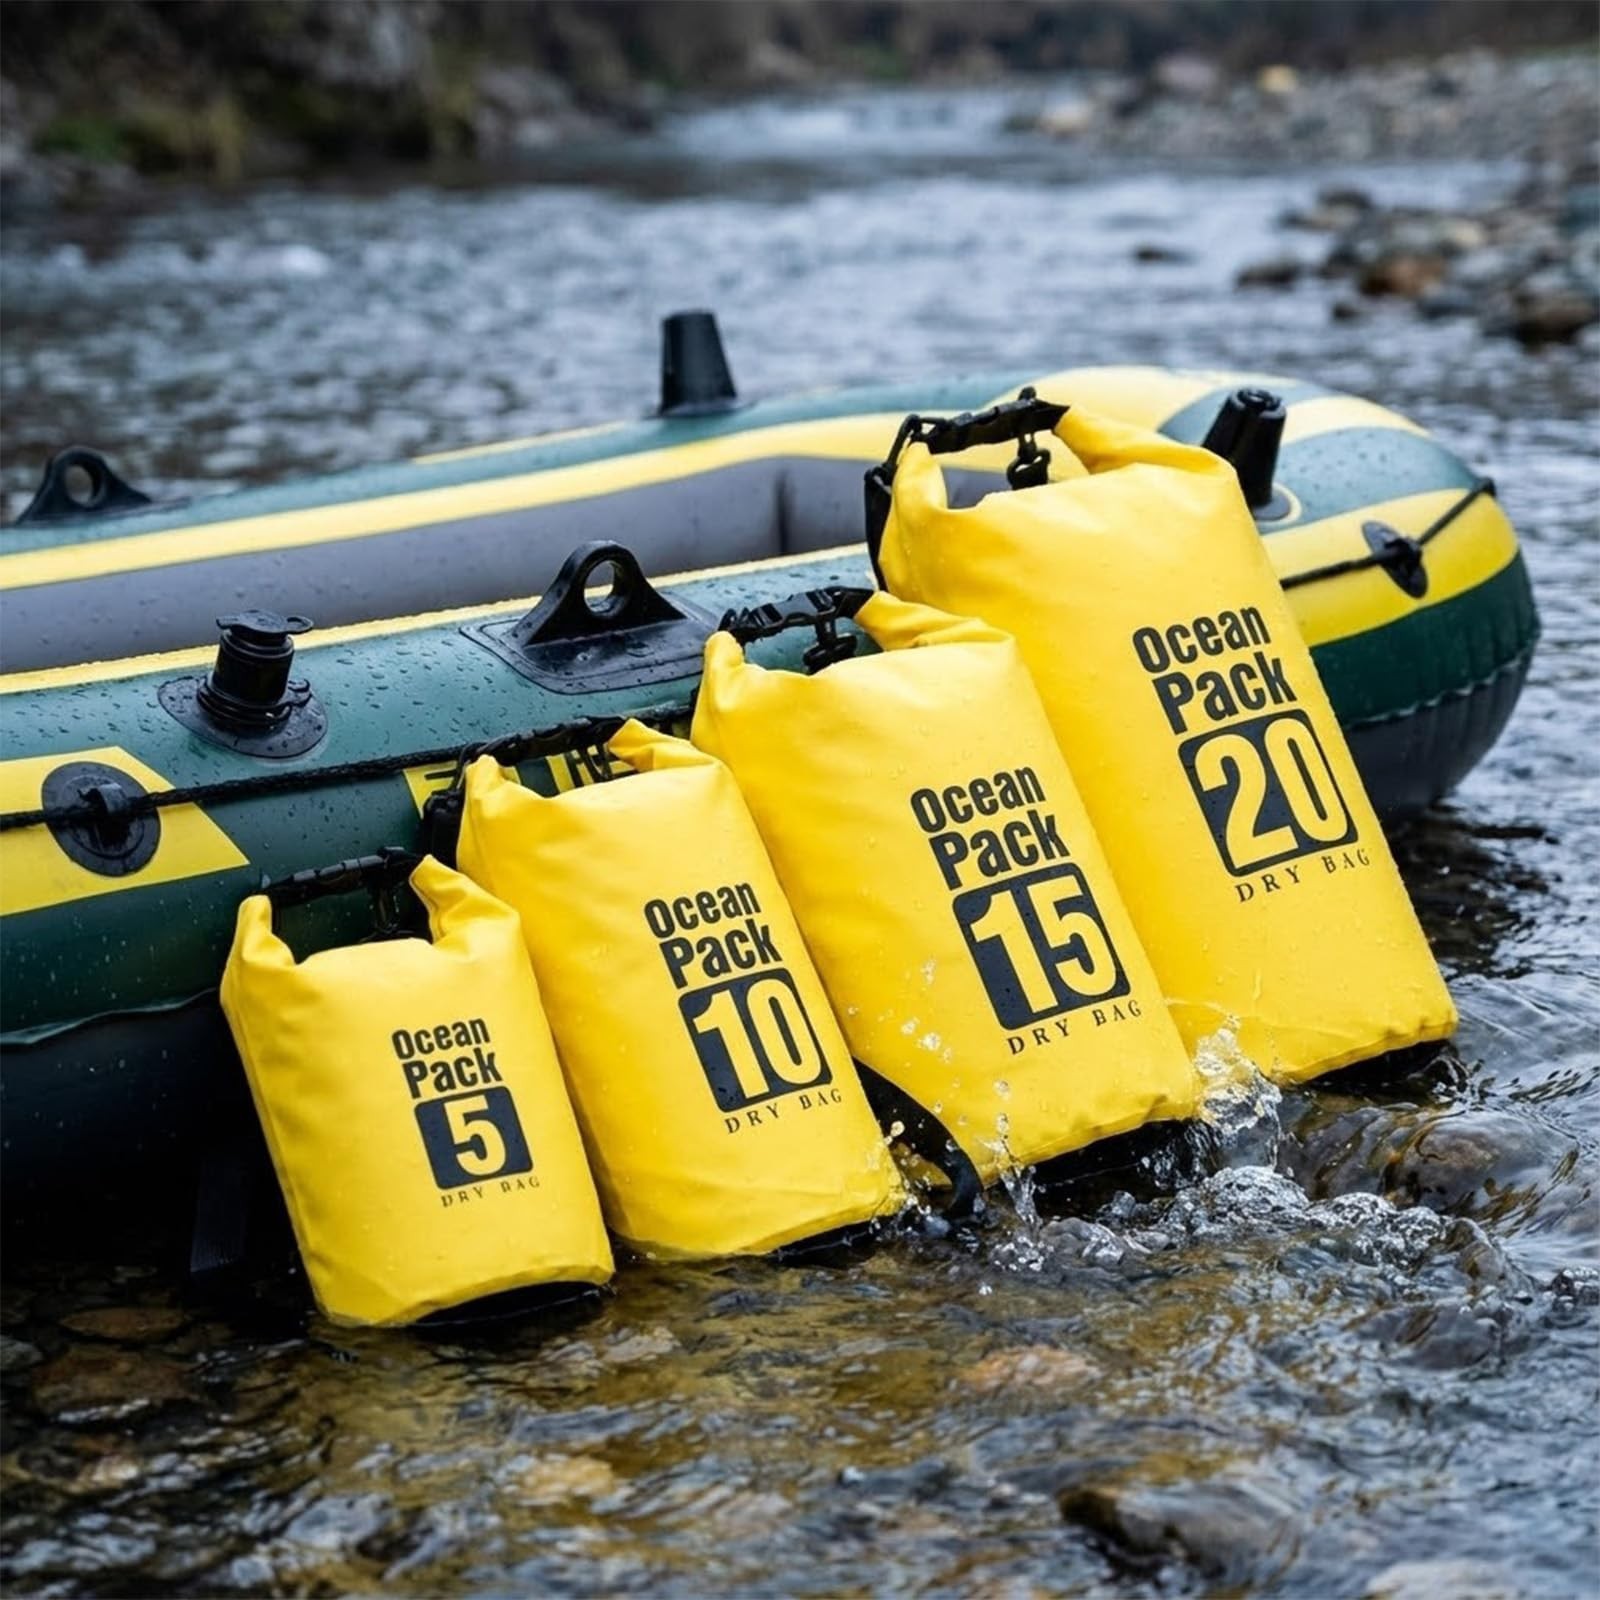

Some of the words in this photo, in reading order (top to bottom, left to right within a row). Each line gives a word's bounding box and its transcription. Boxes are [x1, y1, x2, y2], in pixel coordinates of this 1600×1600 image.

[1132, 605, 1271, 674] Ocean
[1152, 651, 1297, 735] Pack
[910, 766, 1046, 833] Ocean
[1194, 717, 1348, 869] 20
[928, 809, 1070, 891] Pack
[1235, 865, 1301, 902] DRY
[1322, 848, 1370, 874] BAG
[644, 882, 761, 938] Ocean
[969, 874, 1117, 1014] 15
[659, 918, 783, 990] Pack
[391, 1018, 490, 1060] Ocean
[693, 978, 822, 1099] 10
[1006, 1018, 1071, 1054] DRY
[1092, 999, 1142, 1026] BAG
[402, 1047, 503, 1099] Pack
[443, 1094, 506, 1176] 5
[724, 1103, 781, 1134] DRY
[799, 1088, 842, 1110] BAG
[441, 1186, 484, 1208] DRY
